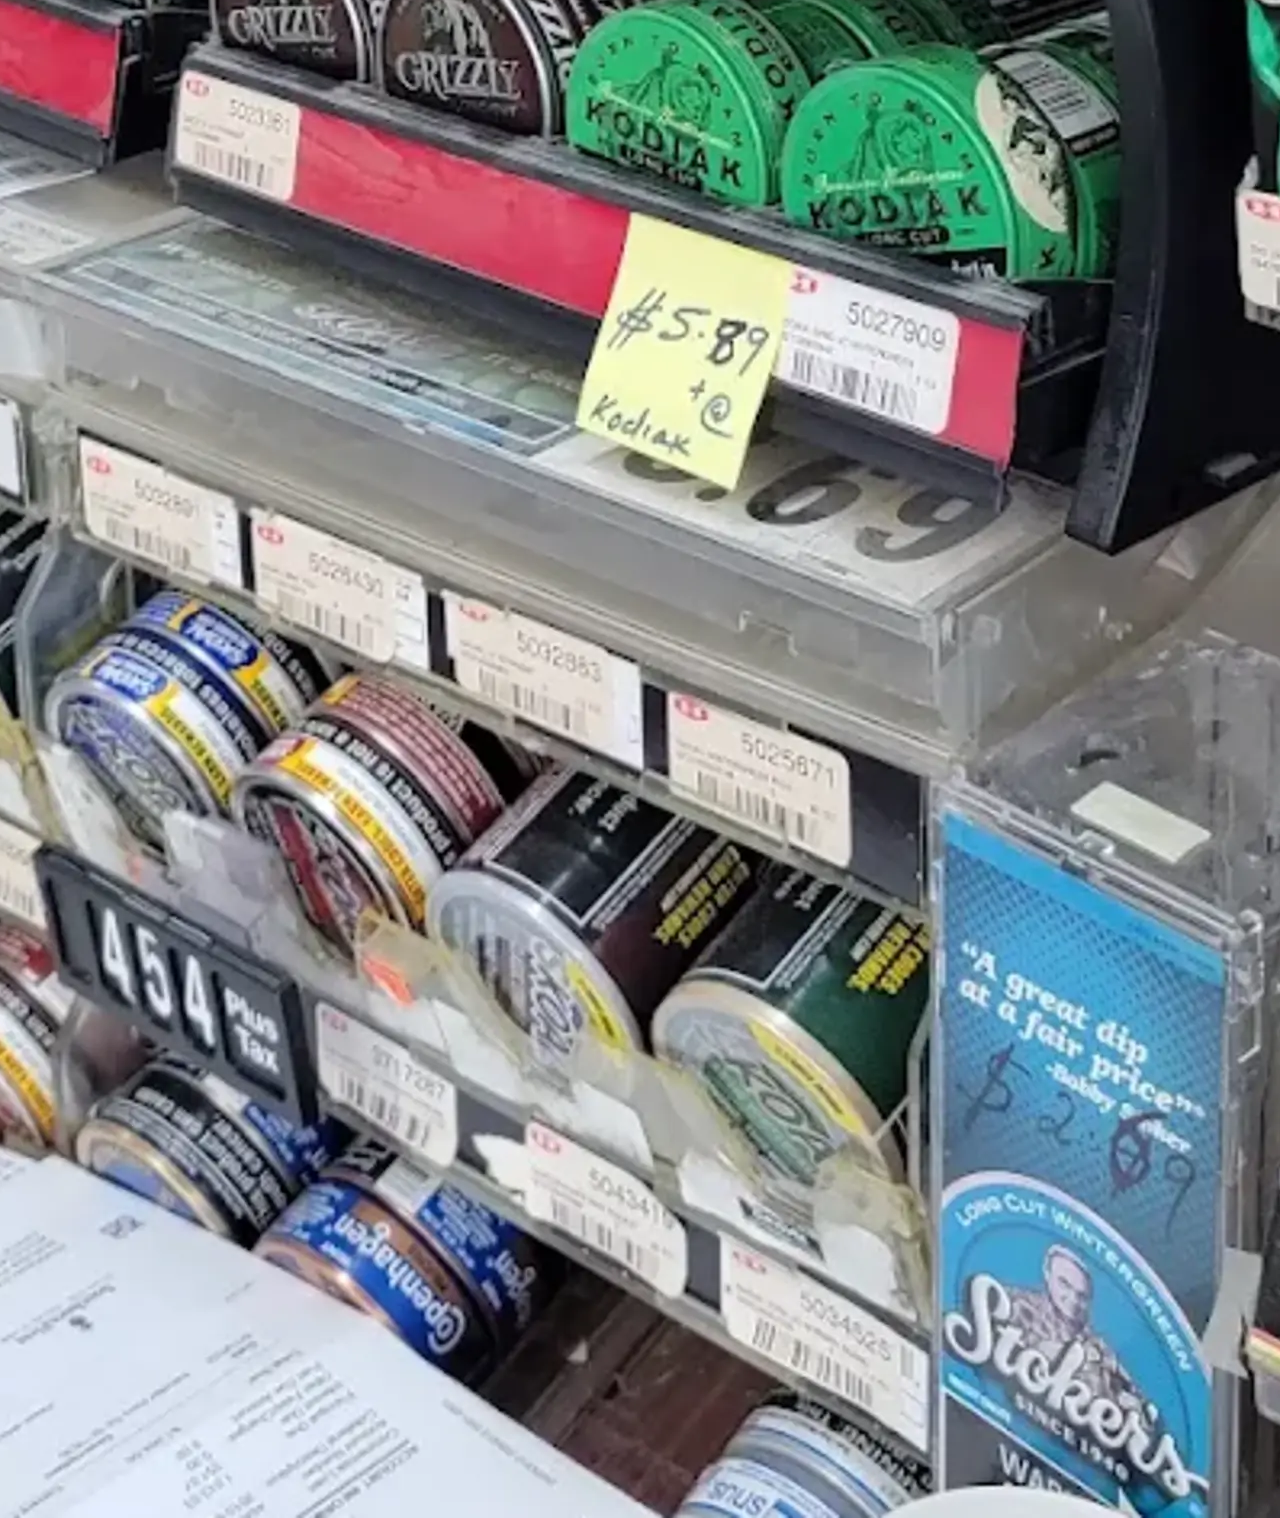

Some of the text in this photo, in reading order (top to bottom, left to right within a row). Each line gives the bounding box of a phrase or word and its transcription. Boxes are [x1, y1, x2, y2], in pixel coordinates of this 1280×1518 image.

[228, 4, 337, 53] GRIZZLY
[394, 51, 521, 102] GRIZZLY
[585, 95, 743, 189] KODIAK
[806, 184, 990, 232] KODIAK
[846, 300, 947, 354] 5027909
[224, 983, 281, 1044] Plus
[959, 979, 992, 1009] at
[998, 1001, 1017, 1025] a
[1019, 1011, 1085, 1059] fair
[1006, 973, 1090, 1031] great
[1095, 1020, 1150, 1065] dip
[231, 1027, 282, 1077] Tax
[333, 1212, 467, 1355] Copenhagen
[955, 1192, 1194, 1372] LONG CUT WINTERGREEN
